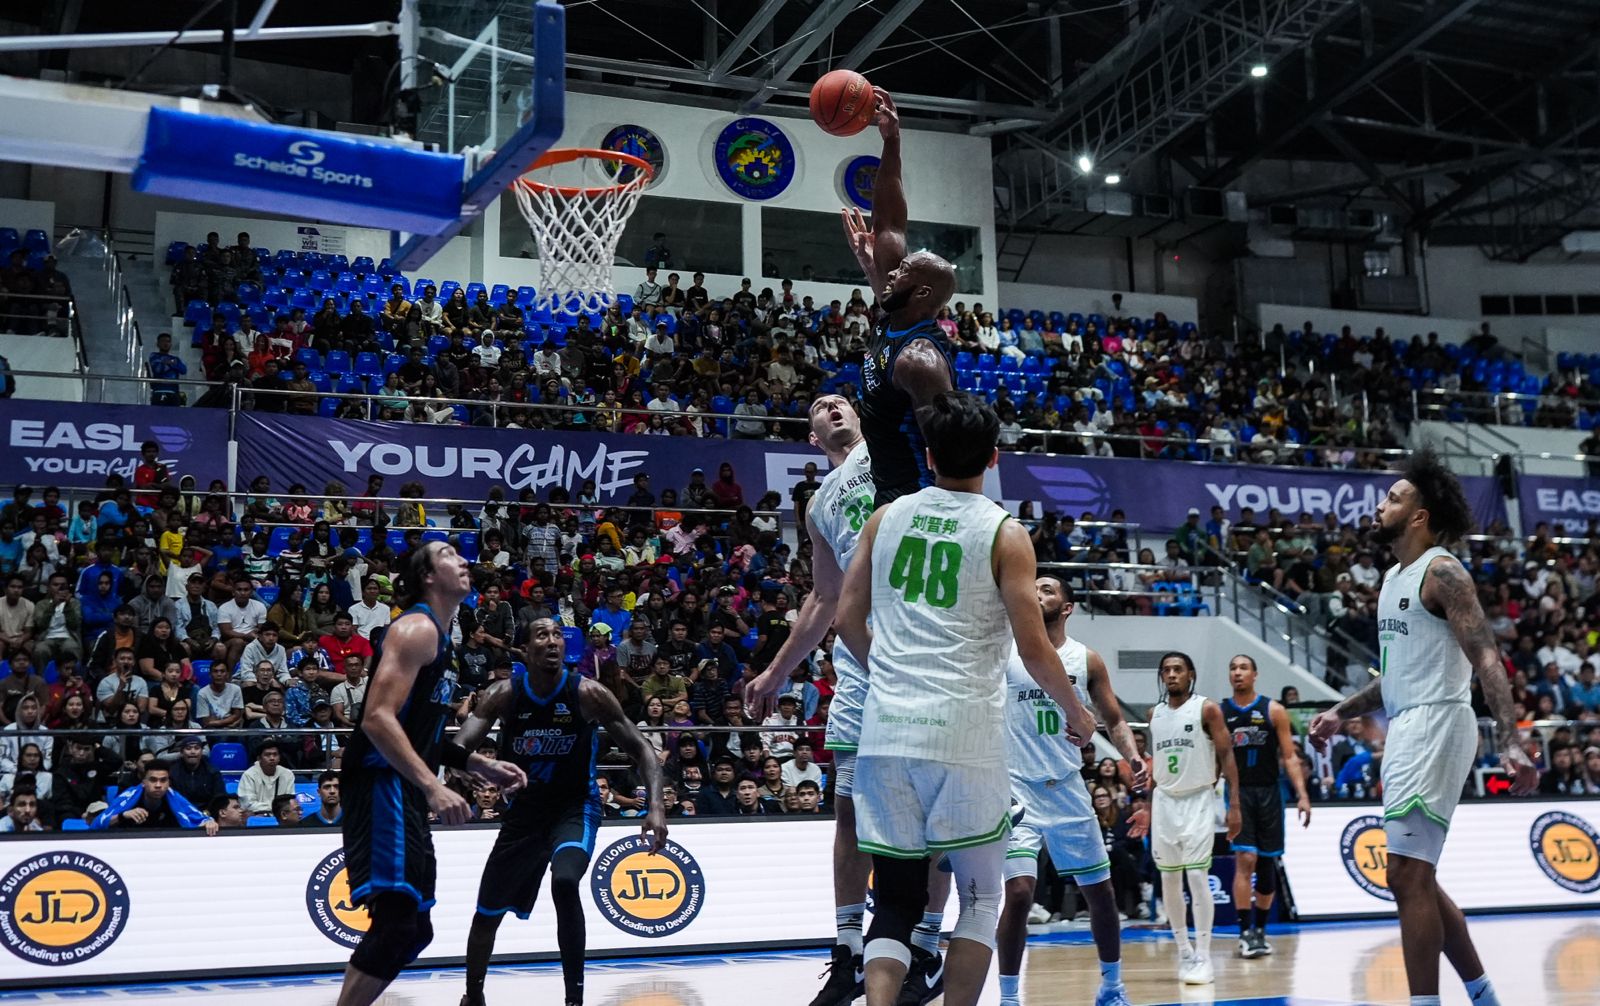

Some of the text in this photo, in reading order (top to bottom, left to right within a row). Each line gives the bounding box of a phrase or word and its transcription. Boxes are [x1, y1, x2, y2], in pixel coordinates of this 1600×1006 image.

[233, 152, 373, 188] Scheide Sports
[10, 419, 143, 451] EASL
[910, 514, 959, 536] 刘晋邦
[888, 535, 964, 610] 48
[1017, 688, 1046, 703] BLACK
[523, 728, 563, 738] MERALCO
[1037, 710, 1060, 736] 10
[1168, 755, 1179, 774] 2
[598, 840, 634, 872] SULONG
[1363, 845, 1388, 870] JL
[2, 854, 118, 893] SULONG PA ILAGAN
[617, 868, 681, 900] JLD
[20, 889, 101, 925] JLD
[314, 898, 337, 932] Journey
[598, 884, 700, 934] Journey Leading to Development
[0, 905, 122, 962] Journey Leading to Development
